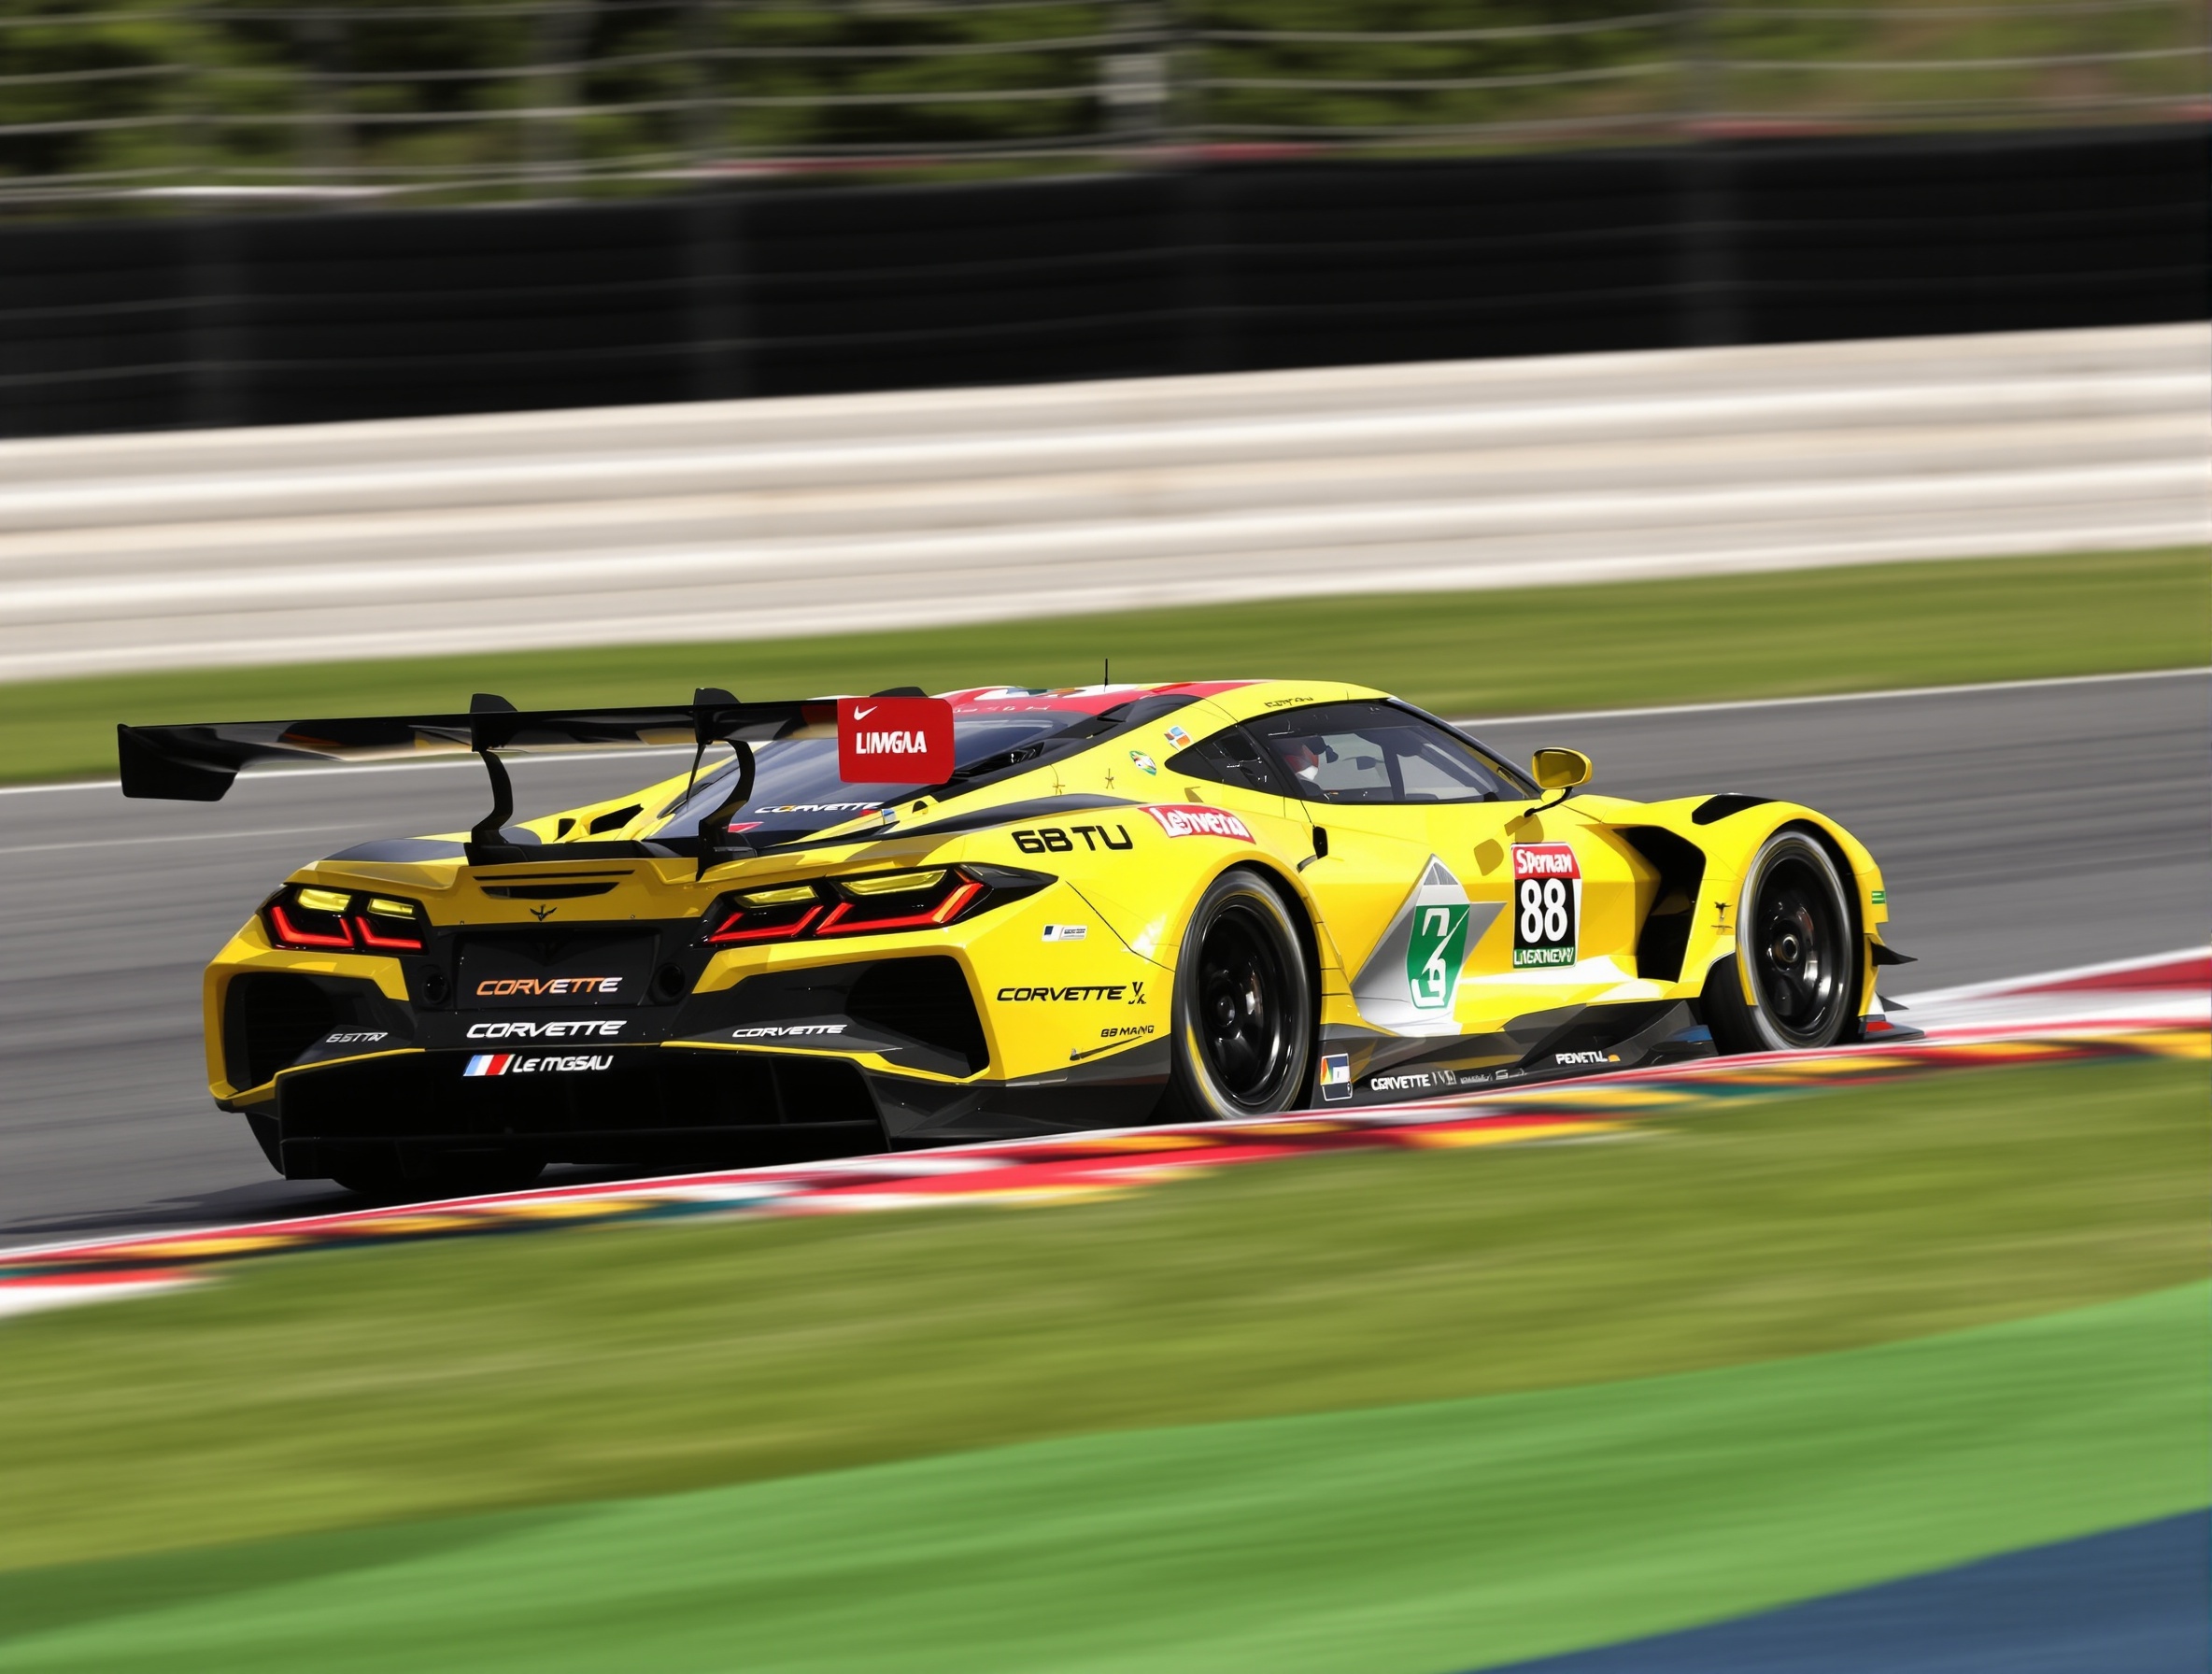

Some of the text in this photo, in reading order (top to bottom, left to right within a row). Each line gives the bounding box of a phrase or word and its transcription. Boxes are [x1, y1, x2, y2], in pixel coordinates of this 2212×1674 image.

[1520, 877, 1568, 943] 88
[476, 977, 623, 997] CORVETTE
[997, 986, 1127, 1001] CORVETTE
[467, 1020, 628, 1039] CORVETTE
[731, 1024, 848, 1038] CORVETTE
